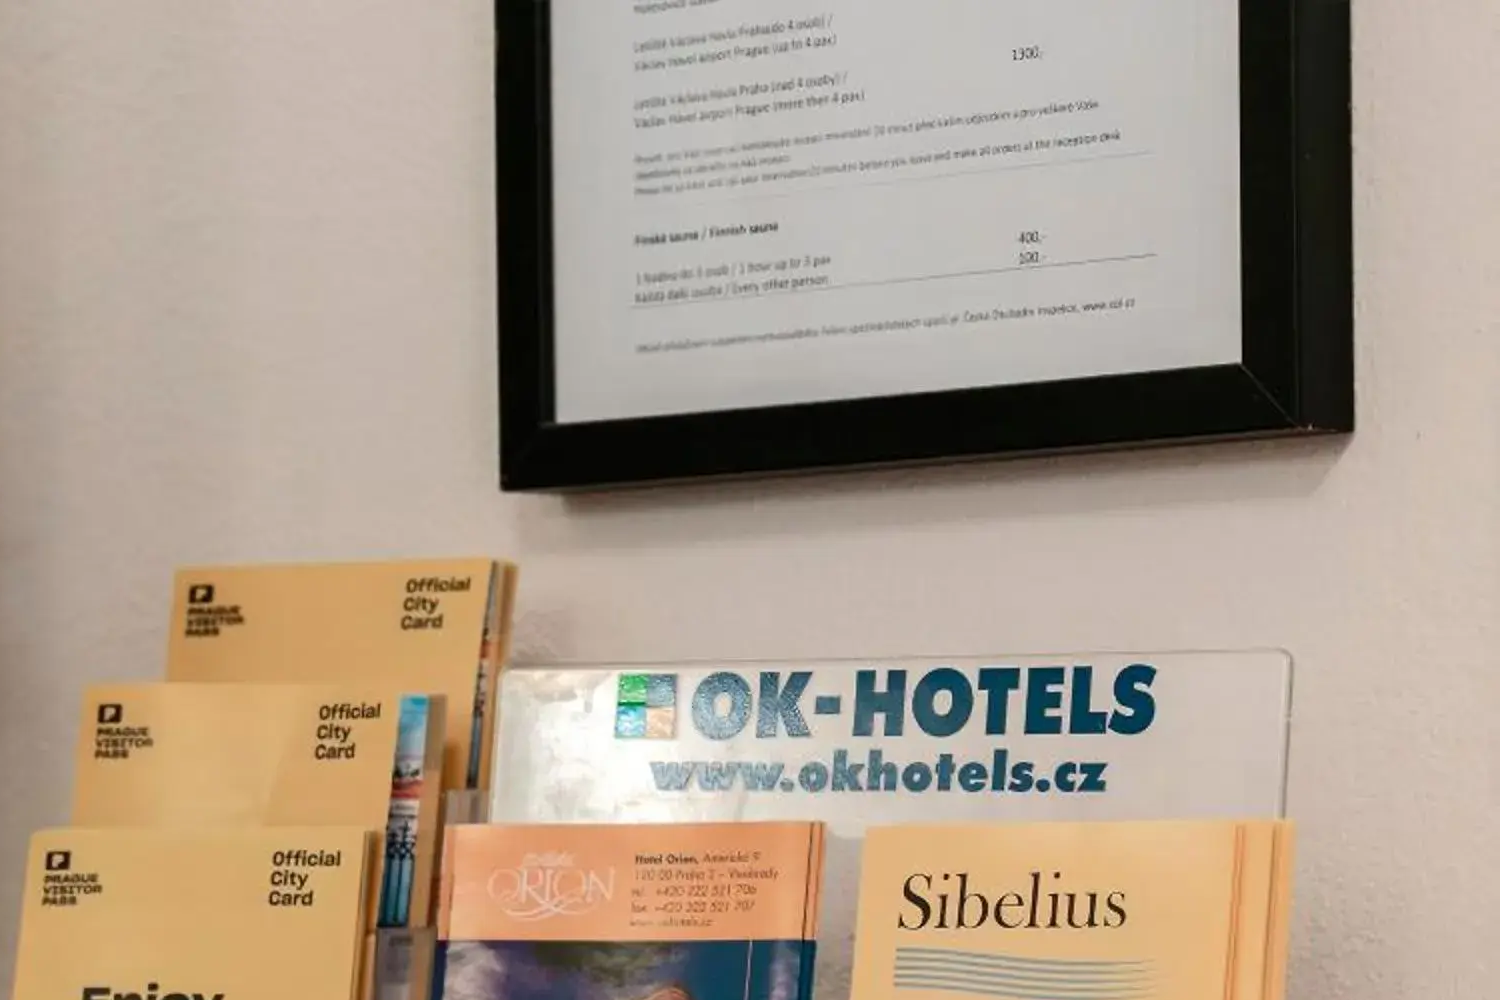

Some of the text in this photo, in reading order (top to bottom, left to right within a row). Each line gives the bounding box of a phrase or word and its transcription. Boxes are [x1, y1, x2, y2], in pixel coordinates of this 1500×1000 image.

[405, 576, 472, 594] Official
[402, 596, 440, 614] City
[400, 614, 444, 631] Card
[690, 664, 1157, 740] OK-HOTELS
[318, 703, 382, 721] Official
[315, 723, 352, 743] City
[313, 743, 356, 760] Card
[649, 749, 1108, 794] www.okhotels.cz
[272, 849, 342, 867] Official
[270, 870, 309, 890] City
[268, 890, 314, 906] Card
[897, 871, 1128, 930] Sibelius
